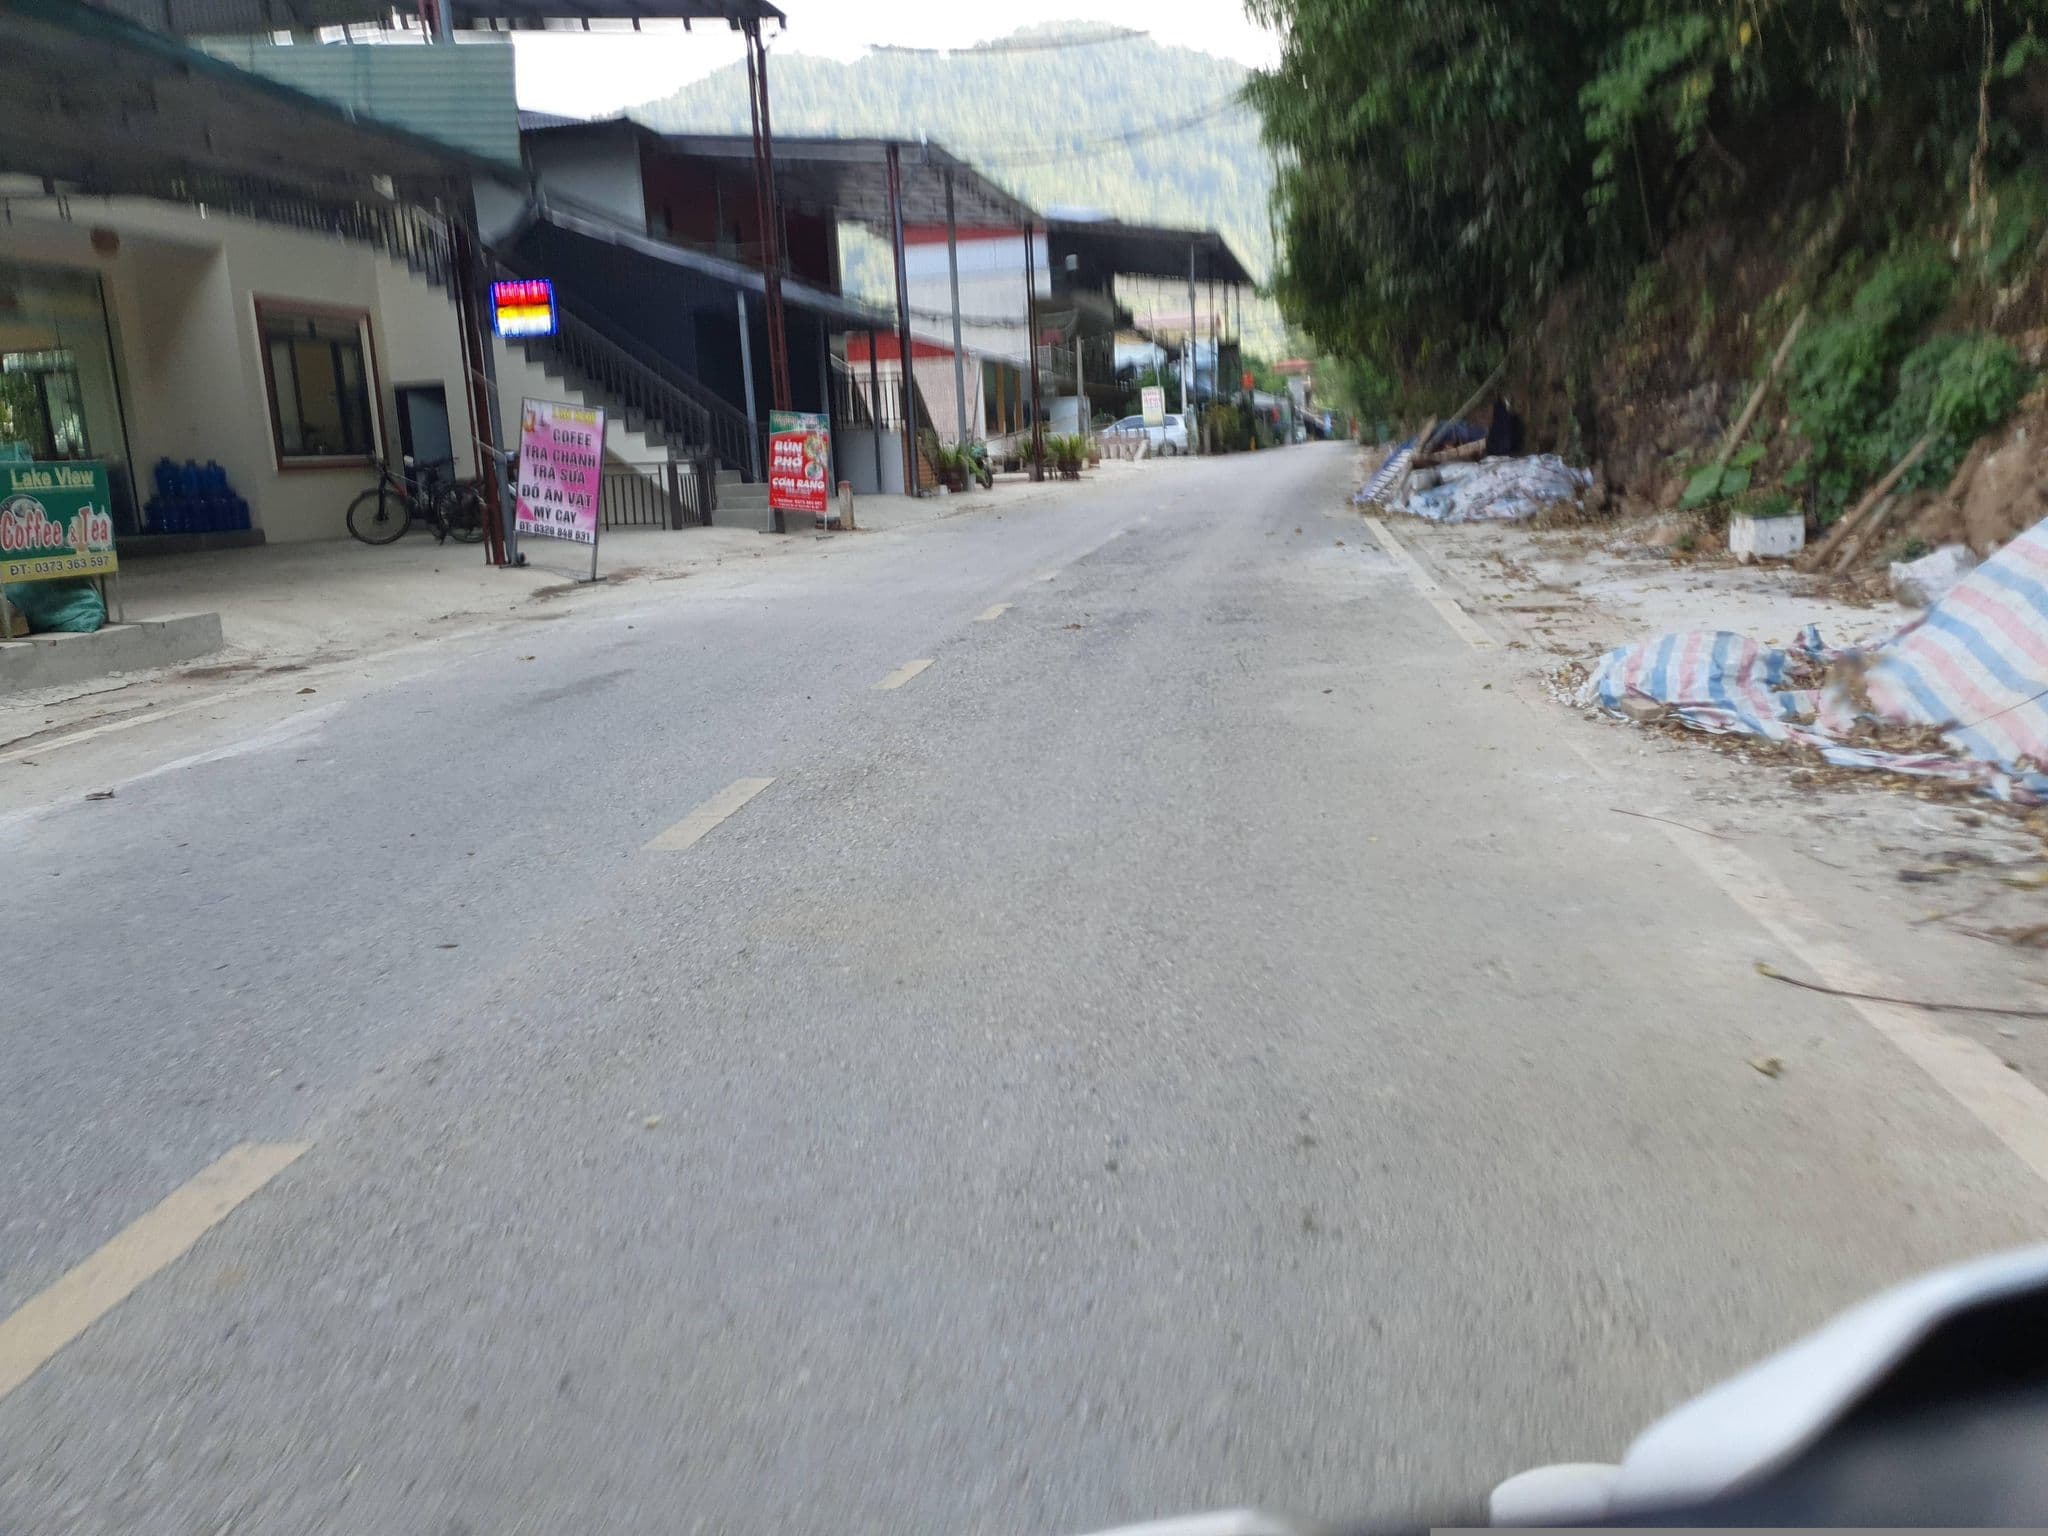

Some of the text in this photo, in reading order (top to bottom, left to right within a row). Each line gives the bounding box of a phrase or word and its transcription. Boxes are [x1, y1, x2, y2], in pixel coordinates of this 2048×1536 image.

[553, 428, 593, 447] COFEE
[10, 467, 95, 488] Lake View
[797, 479, 825, 490] RANG
[555, 508, 577, 524] CAY
[1, 510, 62, 550] Coffee
[79, 505, 109, 546] Tea
[35, 561, 63, 573] 0373
[67, 558, 87, 570] 363
[91, 556, 109, 567] 597
